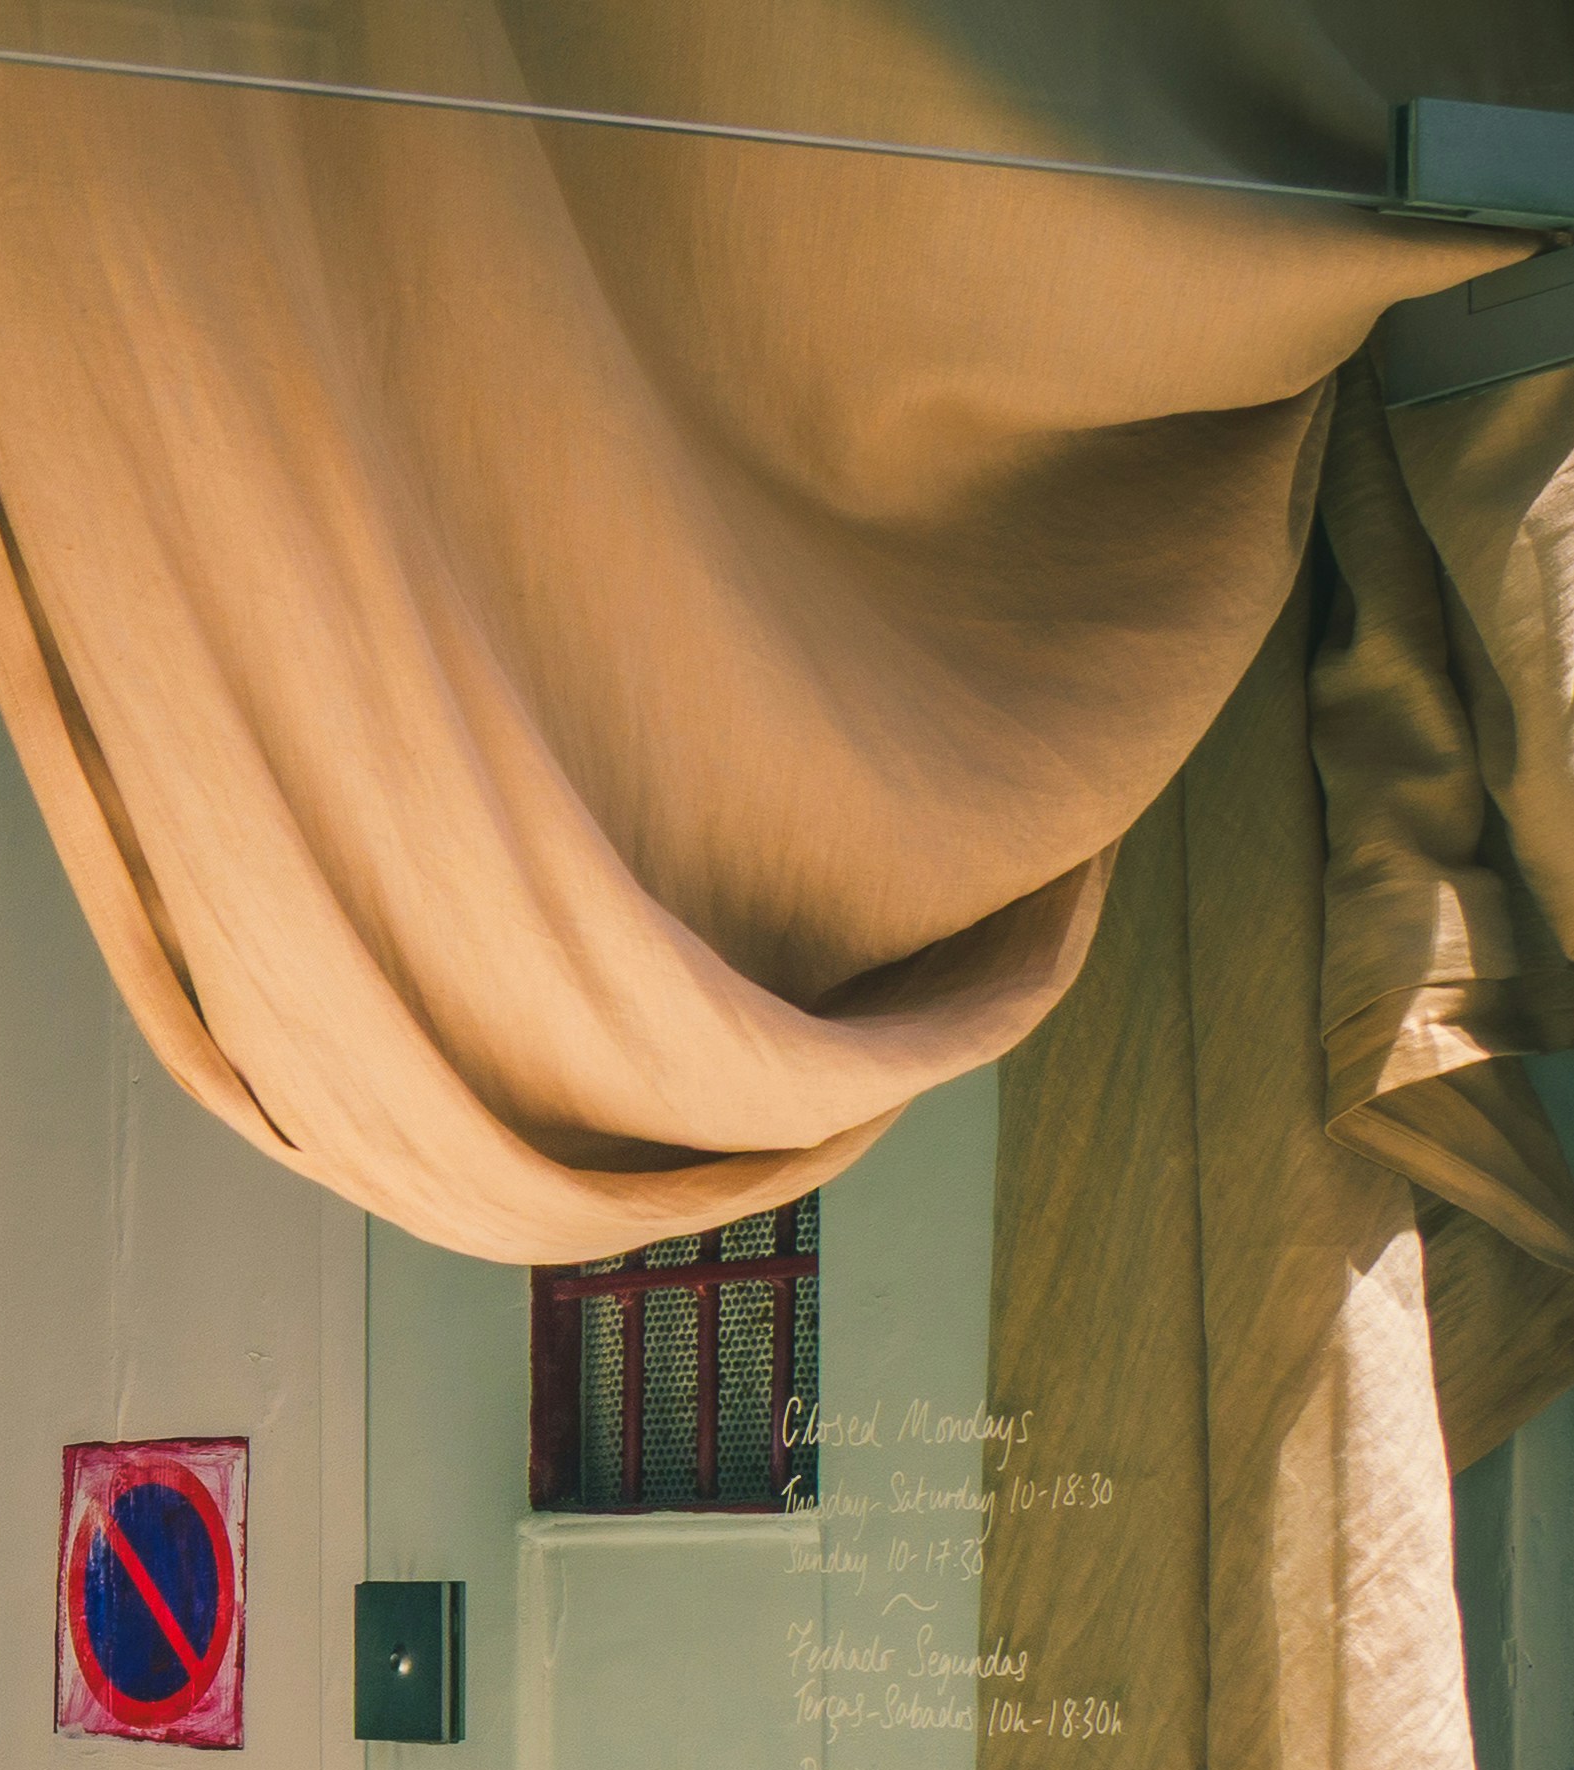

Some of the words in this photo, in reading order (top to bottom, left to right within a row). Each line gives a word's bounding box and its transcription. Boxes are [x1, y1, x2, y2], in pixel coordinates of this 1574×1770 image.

[781, 1396, 882, 1449] Closed
[897, 1398, 1035, 1471] Mondays
[1009, 1471, 1115, 1514] 10-18:30
[782, 1542, 870, 1597] Sunday
[788, 1618, 896, 1679] Fechado
[907, 1623, 1030, 1694] Segundas
